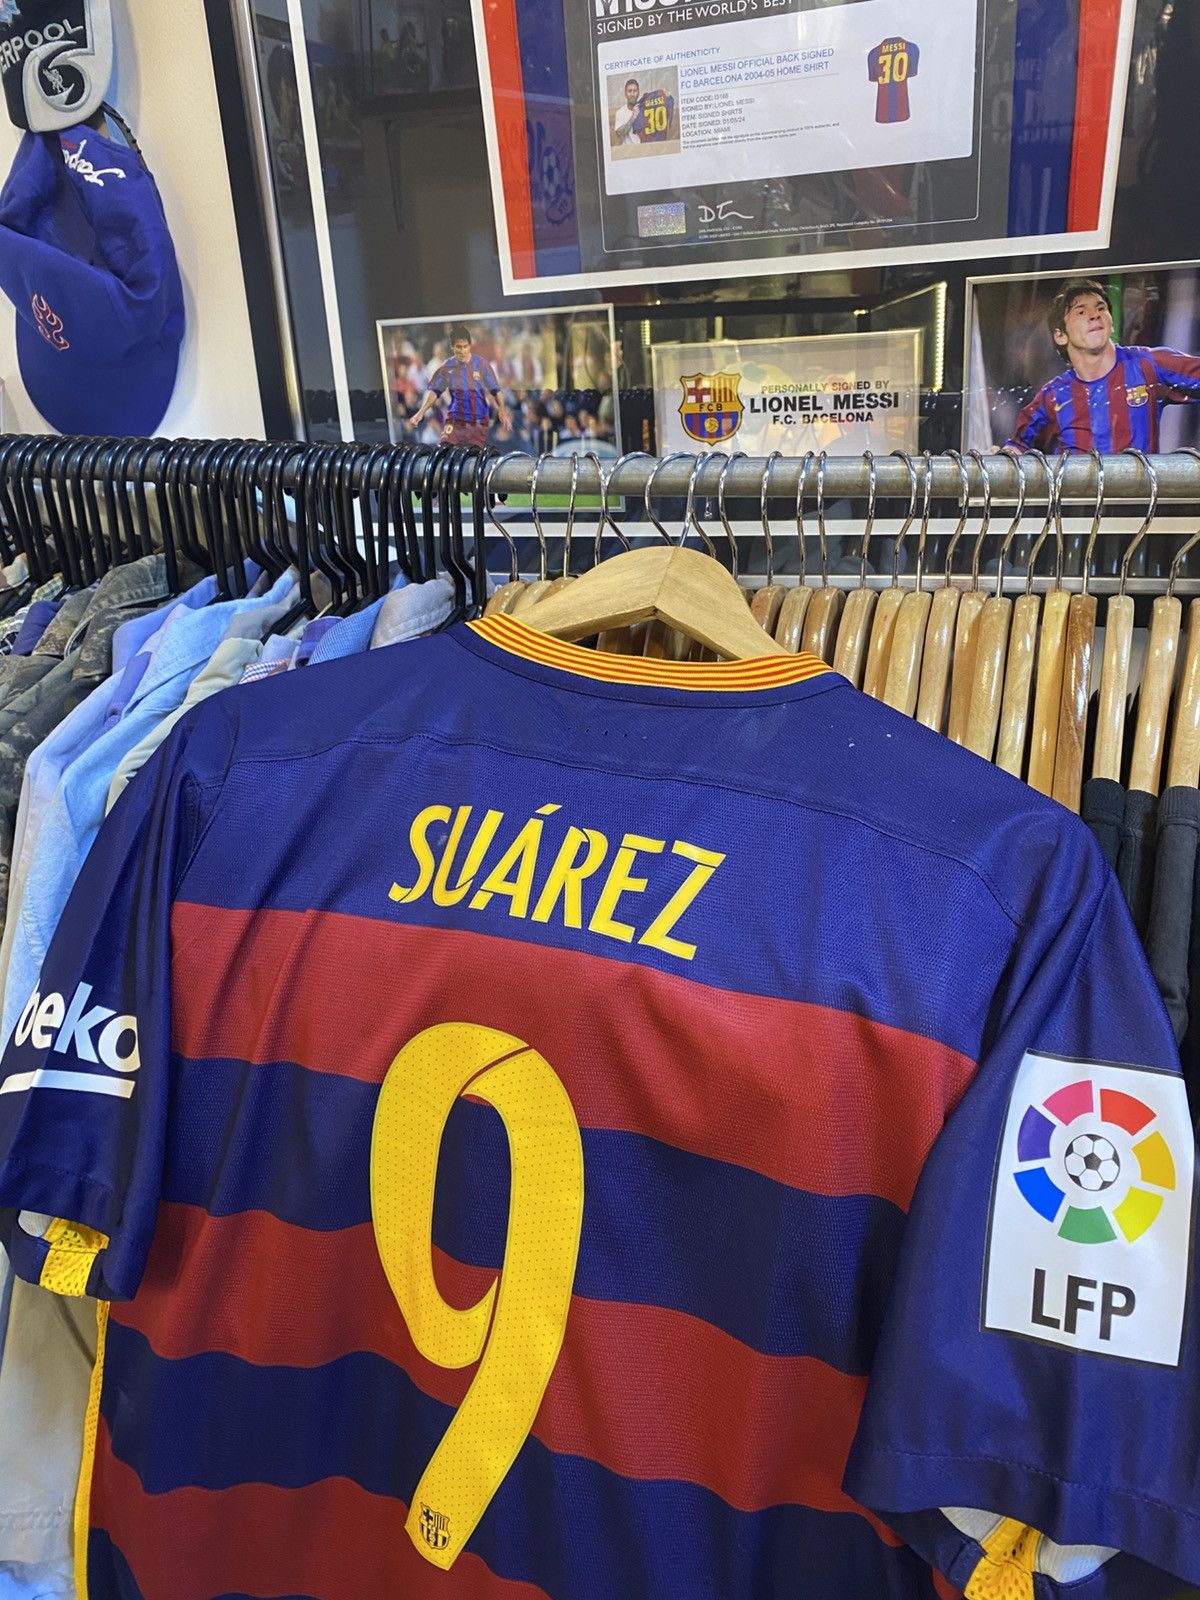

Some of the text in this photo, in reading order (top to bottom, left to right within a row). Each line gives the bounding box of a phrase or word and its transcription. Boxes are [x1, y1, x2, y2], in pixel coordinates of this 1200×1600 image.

[597, 17, 643, 35] SIGNED
[648, 13, 664, 26] BY
[667, 8, 692, 22] THE
[695, 0, 757, 18] WORLD'S
[605, 47, 721, 70] CERTIFICATE OF AUTHENTICITY
[882, 42, 906, 53] MESSI
[681, 48, 835, 78] LIONEL MESSI OFFICIAL BACK SIGNED
[681, 61, 830, 89] FC BARCELONA 2004-05 HOME SHIRT
[879, 52, 908, 84] 30
[681, 97, 694, 105] ITEM
[681, 105, 703, 113] SIGNED
[644, 106, 668, 134] 30
[682, 122, 697, 130] DATE
[761, 380, 890, 394] PERSONALLY SIGNED BY
[750, 392, 899, 413] LIONEL MESSI
[773, 411, 874, 425] F.C. BACELONA
[388, 803, 726, 960] SUÁREZ
[370, 1022, 584, 1570] 9
[1031, 1268, 1136, 1341] LFP
